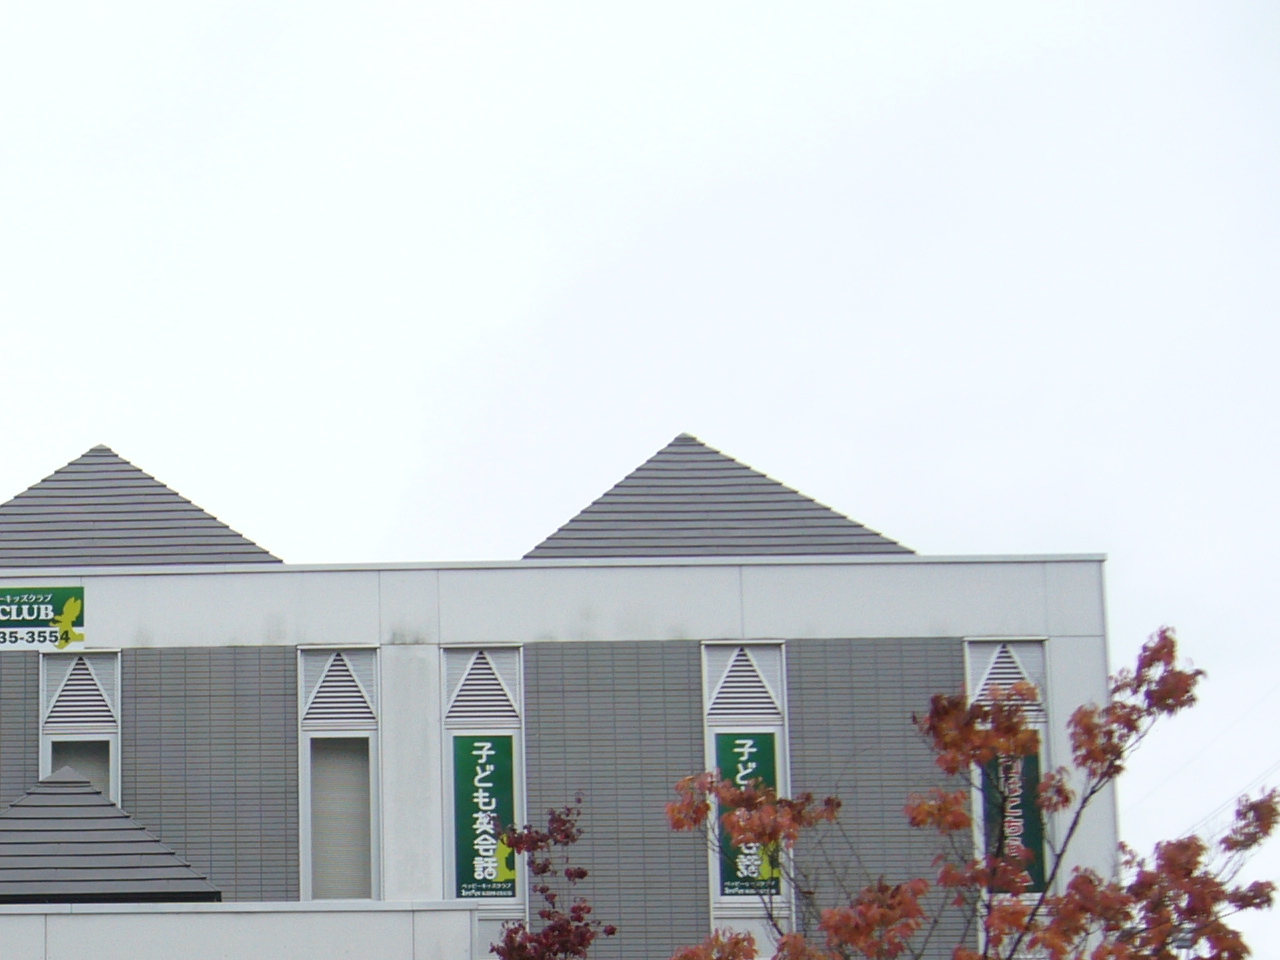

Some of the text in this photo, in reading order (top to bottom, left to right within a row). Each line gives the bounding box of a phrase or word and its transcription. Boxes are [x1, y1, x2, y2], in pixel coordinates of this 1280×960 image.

[472, 741, 499, 881] 子ども英会話
